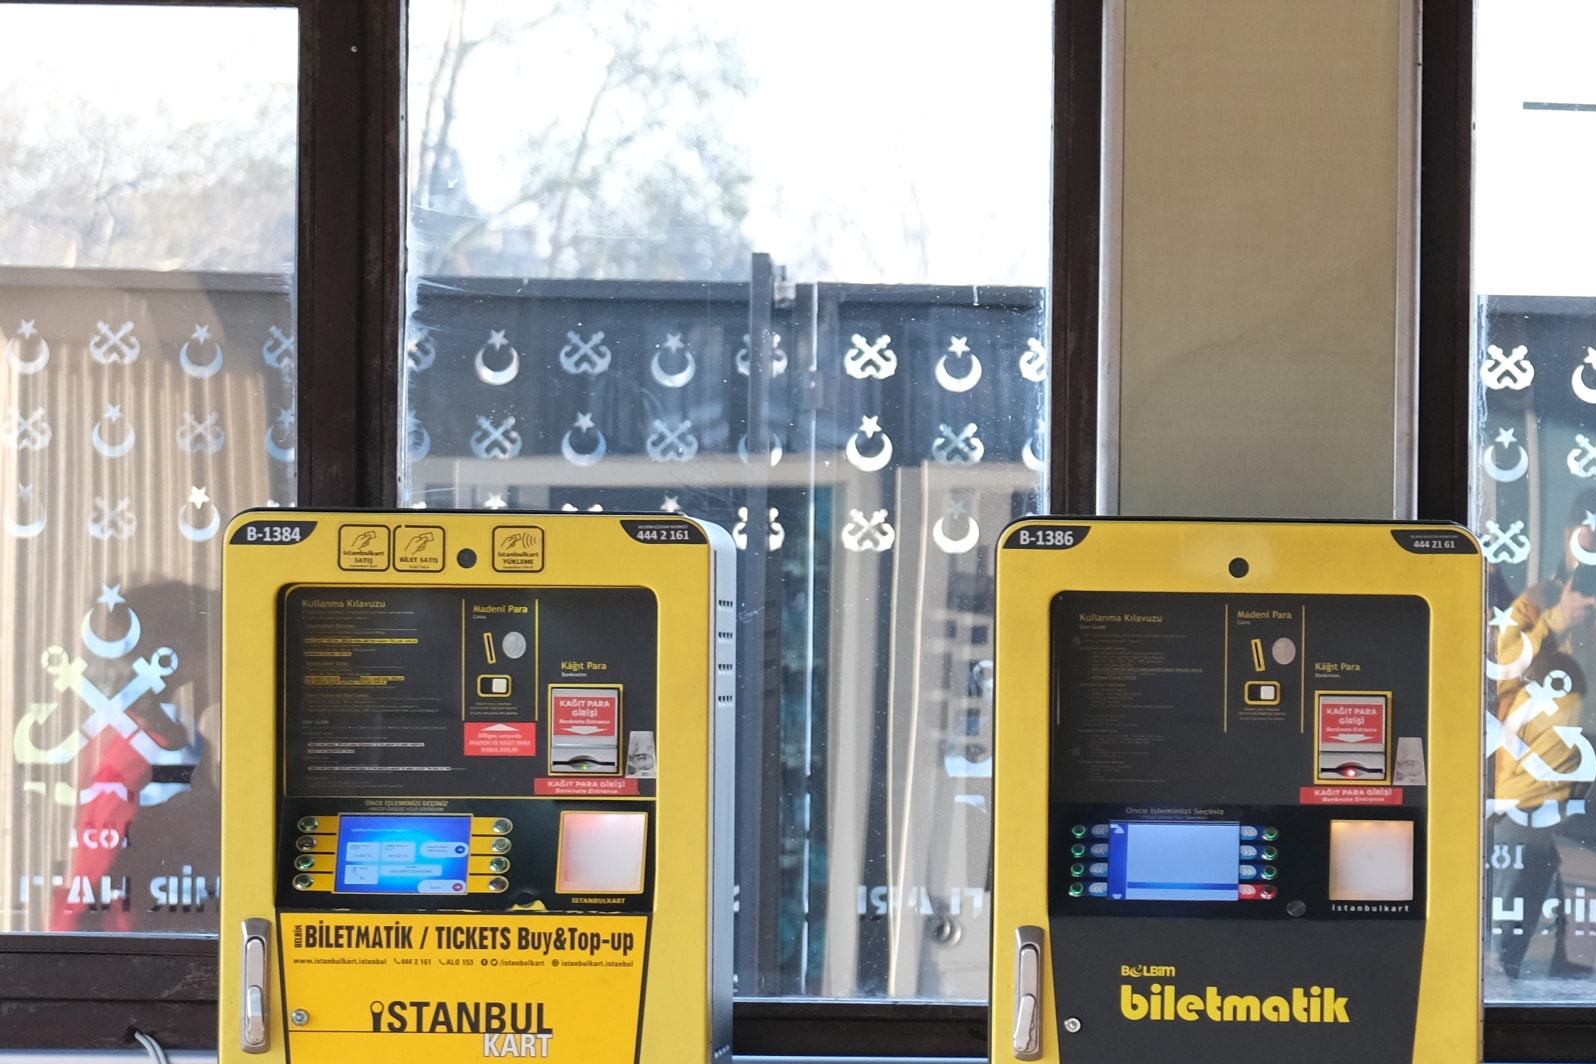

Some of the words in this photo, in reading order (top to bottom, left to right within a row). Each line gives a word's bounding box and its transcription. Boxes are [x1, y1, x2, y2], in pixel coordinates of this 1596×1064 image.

[247, 526, 301, 542] B-1384
[637, 530, 657, 540] 444
[660, 530, 667, 540] 2
[670, 530, 689, 540] 161
[1019, 530, 1074, 546] B-1386
[1413, 540, 1430, 548] 444
[1431, 540, 1442, 548] 21
[1444, 540, 1455, 548] 61
[473, 604, 506, 613] Madeni
[508, 605, 528, 613] Para
[1080, 613, 1121, 622] Kullanma
[1237, 610, 1269, 619] Madeni
[1272, 611, 1292, 619] Para
[587, 662, 607, 670] Para
[1341, 662, 1360, 671] Para
[560, 699, 584, 708] KAĞIT
[585, 700, 610, 708] PARA
[572, 708, 598, 718] GİRİŞİ
[1326, 707, 1352, 715] KAĞIT
[1339, 716, 1365, 725] GİRİŞİ
[548, 780, 575, 788] KAĞIT
[576, 780, 599, 788] PARA
[1314, 788, 1340, 796] KAĞIT
[1366, 788, 1392, 797] GİRİŞİ
[305, 920, 413, 949] BİLETMATİK
[435, 927, 512, 950] TICKETS
[518, 926, 634, 957] Buy&Top-up
[1120, 983, 1351, 1023] biletmatik
[483, 1033, 552, 1057] KART
